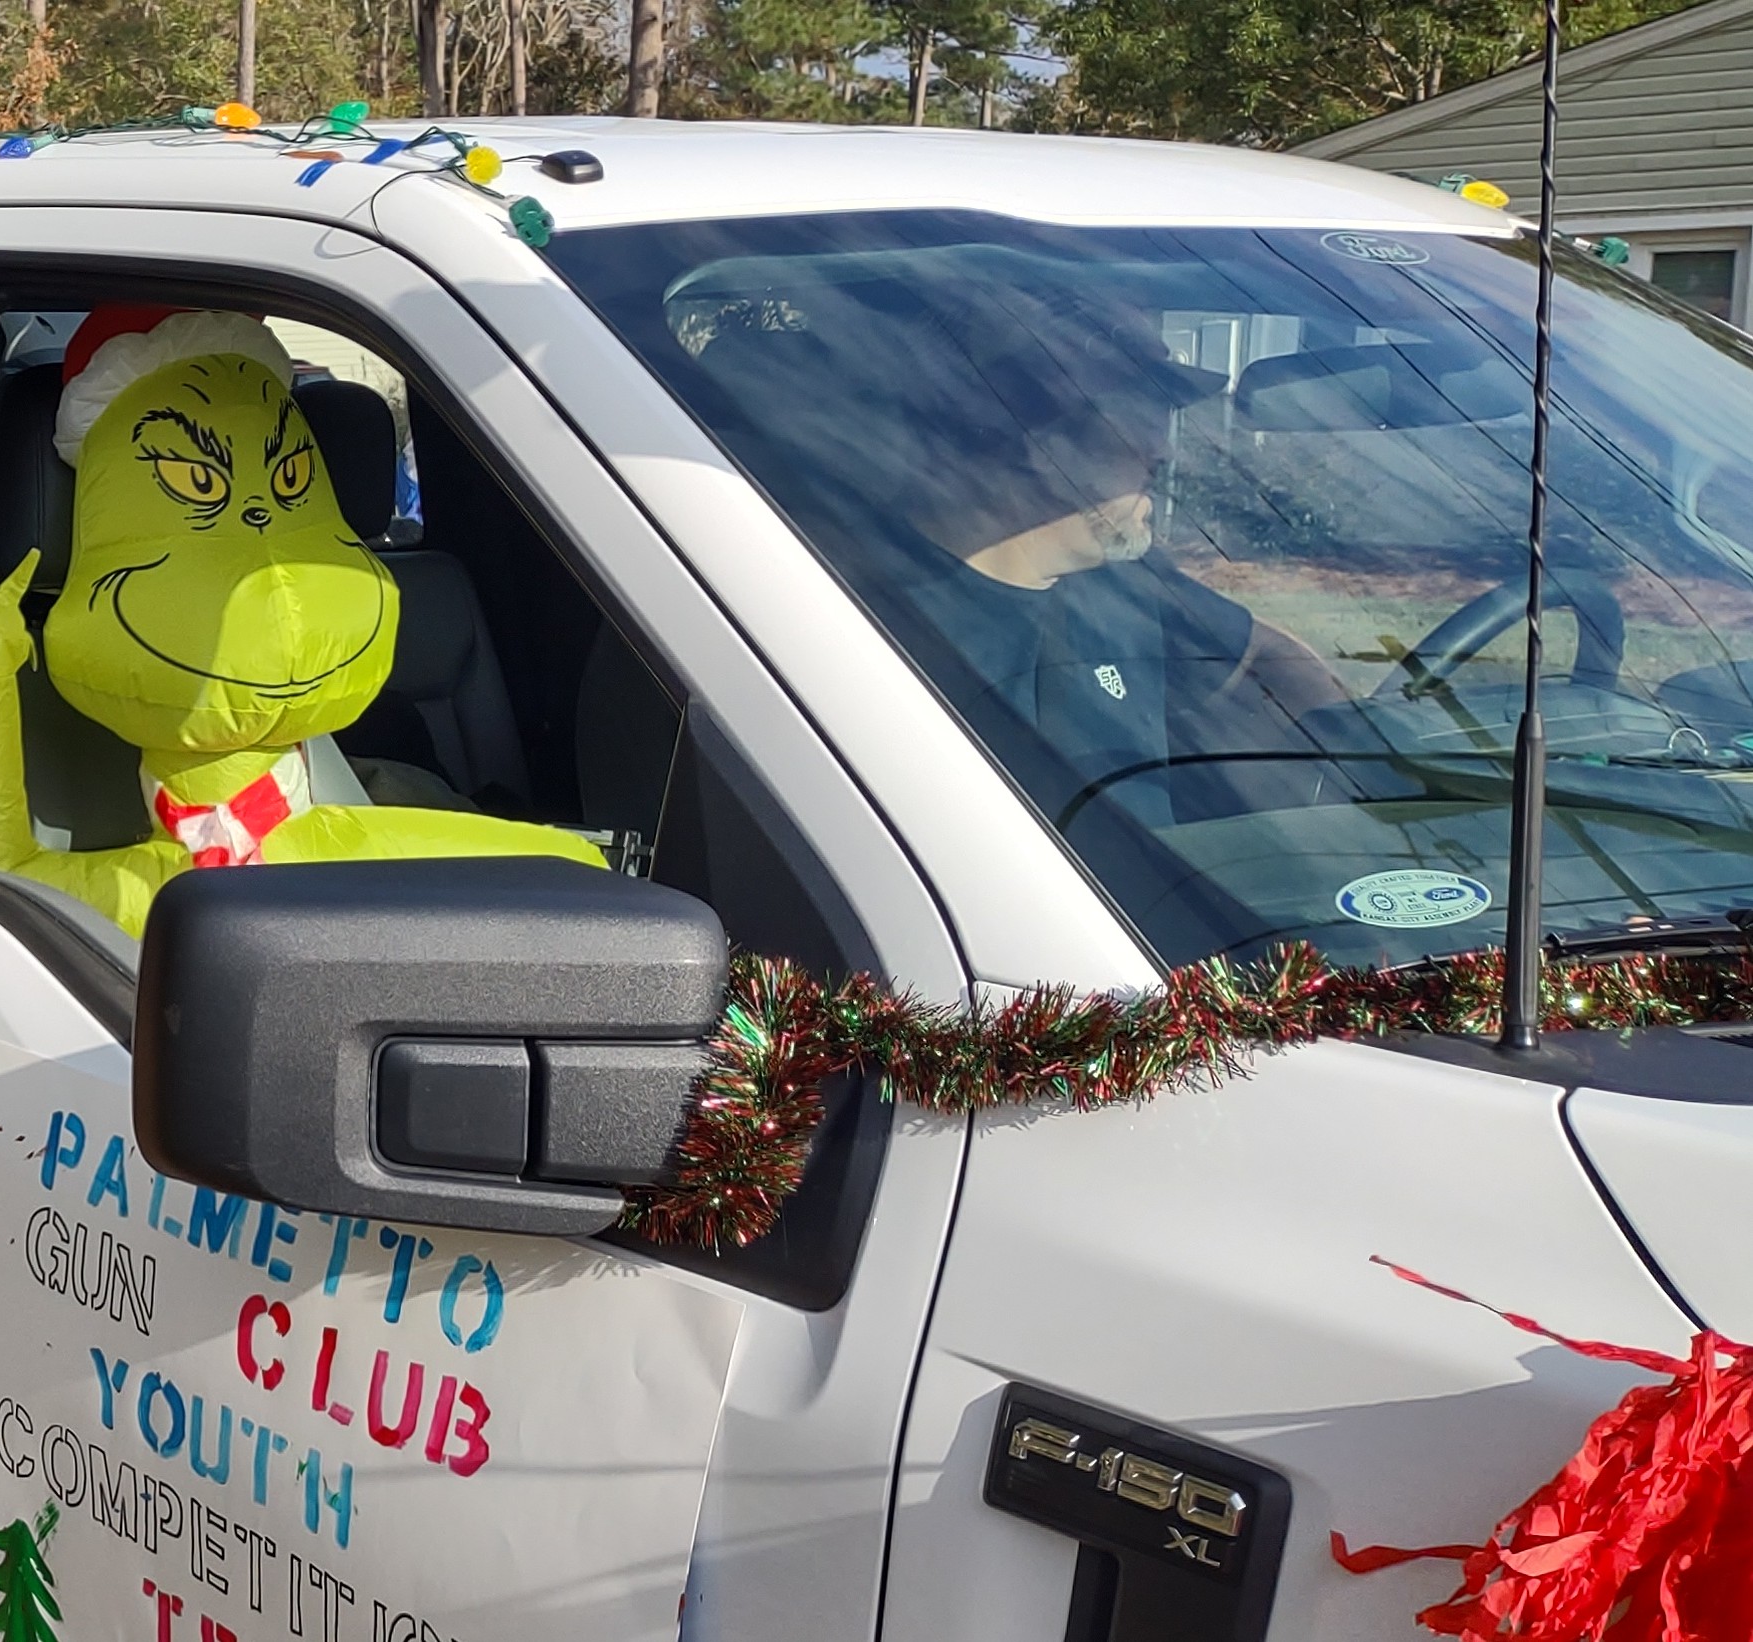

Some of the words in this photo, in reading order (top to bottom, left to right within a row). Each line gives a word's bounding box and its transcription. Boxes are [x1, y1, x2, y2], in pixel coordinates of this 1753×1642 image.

[1337, 235, 1417, 260] Ford
[25, 1206, 157, 1336] GUN
[39, 1110, 506, 1355] PALMETTO
[88, 1347, 355, 1551] YOUTH
[236, 1294, 492, 1478] CLUB
[1007, 1417, 1247, 1537] F-150
[1162, 1526, 1221, 1568] XL
